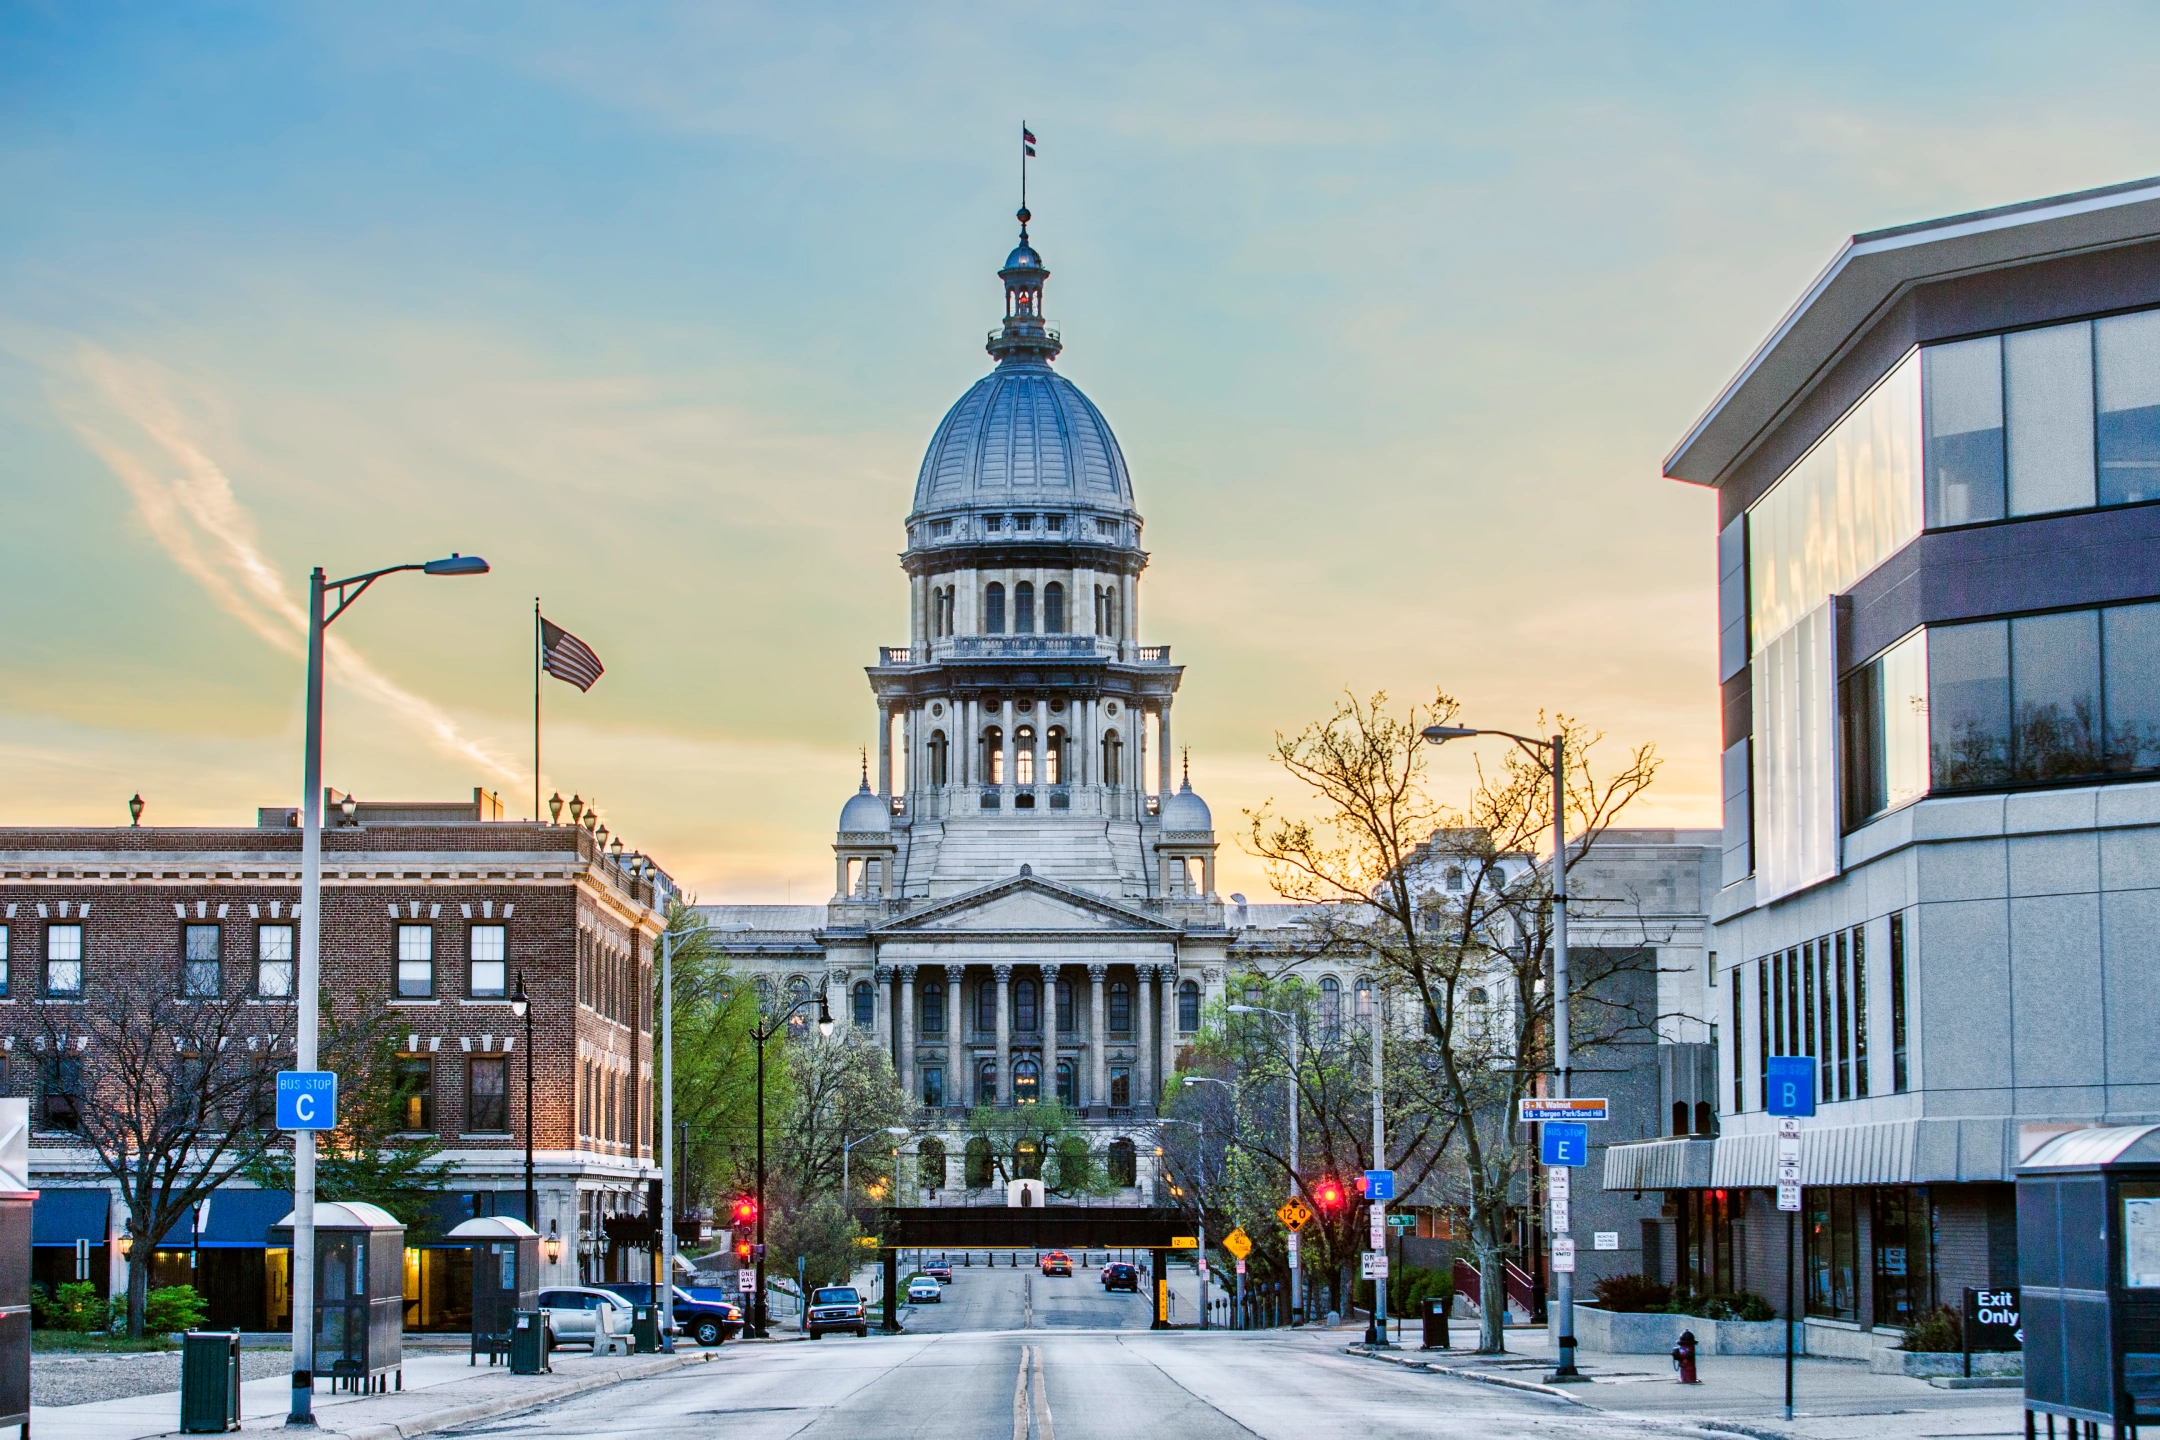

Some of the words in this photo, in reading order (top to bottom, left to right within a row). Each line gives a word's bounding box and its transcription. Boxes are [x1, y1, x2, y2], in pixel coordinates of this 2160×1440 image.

[281, 1079, 300, 1090] BUS
[306, 1079, 332, 1090] STOP
[1782, 1082, 1796, 1108] B
[296, 1093, 315, 1121] C
[1524, 1101, 1530, 1109] 5
[1545, 1101, 1571, 1109] Walnut
[1524, 1110, 1534, 1118] 16
[1540, 1110, 1561, 1119] Bergen
[1784, 1121, 1794, 1130] NO
[1546, 1128, 1562, 1136] BUS
[1564, 1128, 1584, 1137] STOP
[1558, 1141, 1570, 1160] E
[1784, 1168, 1794, 1178] NO
[1375, 1182, 1383, 1196] E
[1977, 1291, 2013, 1307] Exit
[1977, 1308, 2020, 1327] Only
